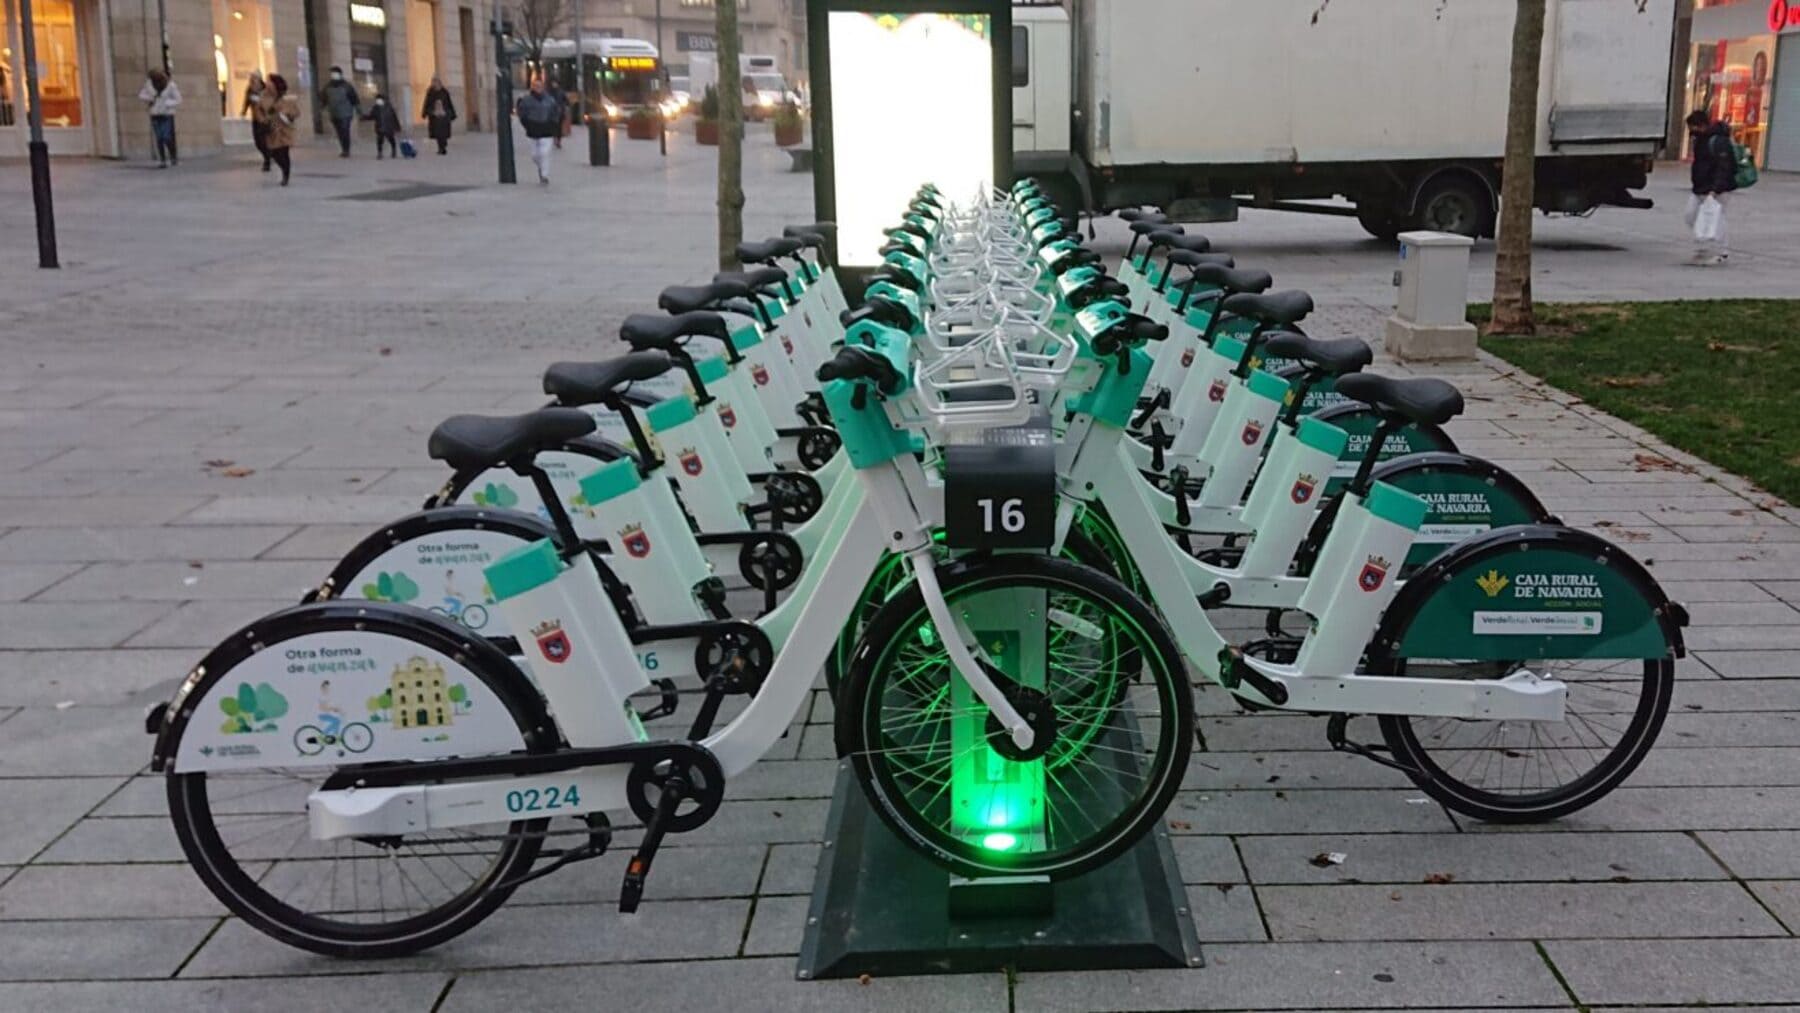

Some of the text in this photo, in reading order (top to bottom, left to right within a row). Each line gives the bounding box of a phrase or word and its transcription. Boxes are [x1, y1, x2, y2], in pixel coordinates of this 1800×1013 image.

[688, 35, 718, 49] BBV
[1384, 434, 1408, 443] RAL
[1448, 493, 1487, 503] RURAL
[1437, 503, 1491, 513] NAVARRA
[977, 498, 1026, 532] 16
[1515, 575, 1598, 586] CAJA RURAL
[1514, 587, 1603, 598] DE NAVARRA
[285, 647, 361, 660] Otra forma
[287, 663, 304, 673] de
[505, 784, 581, 813] 0224
